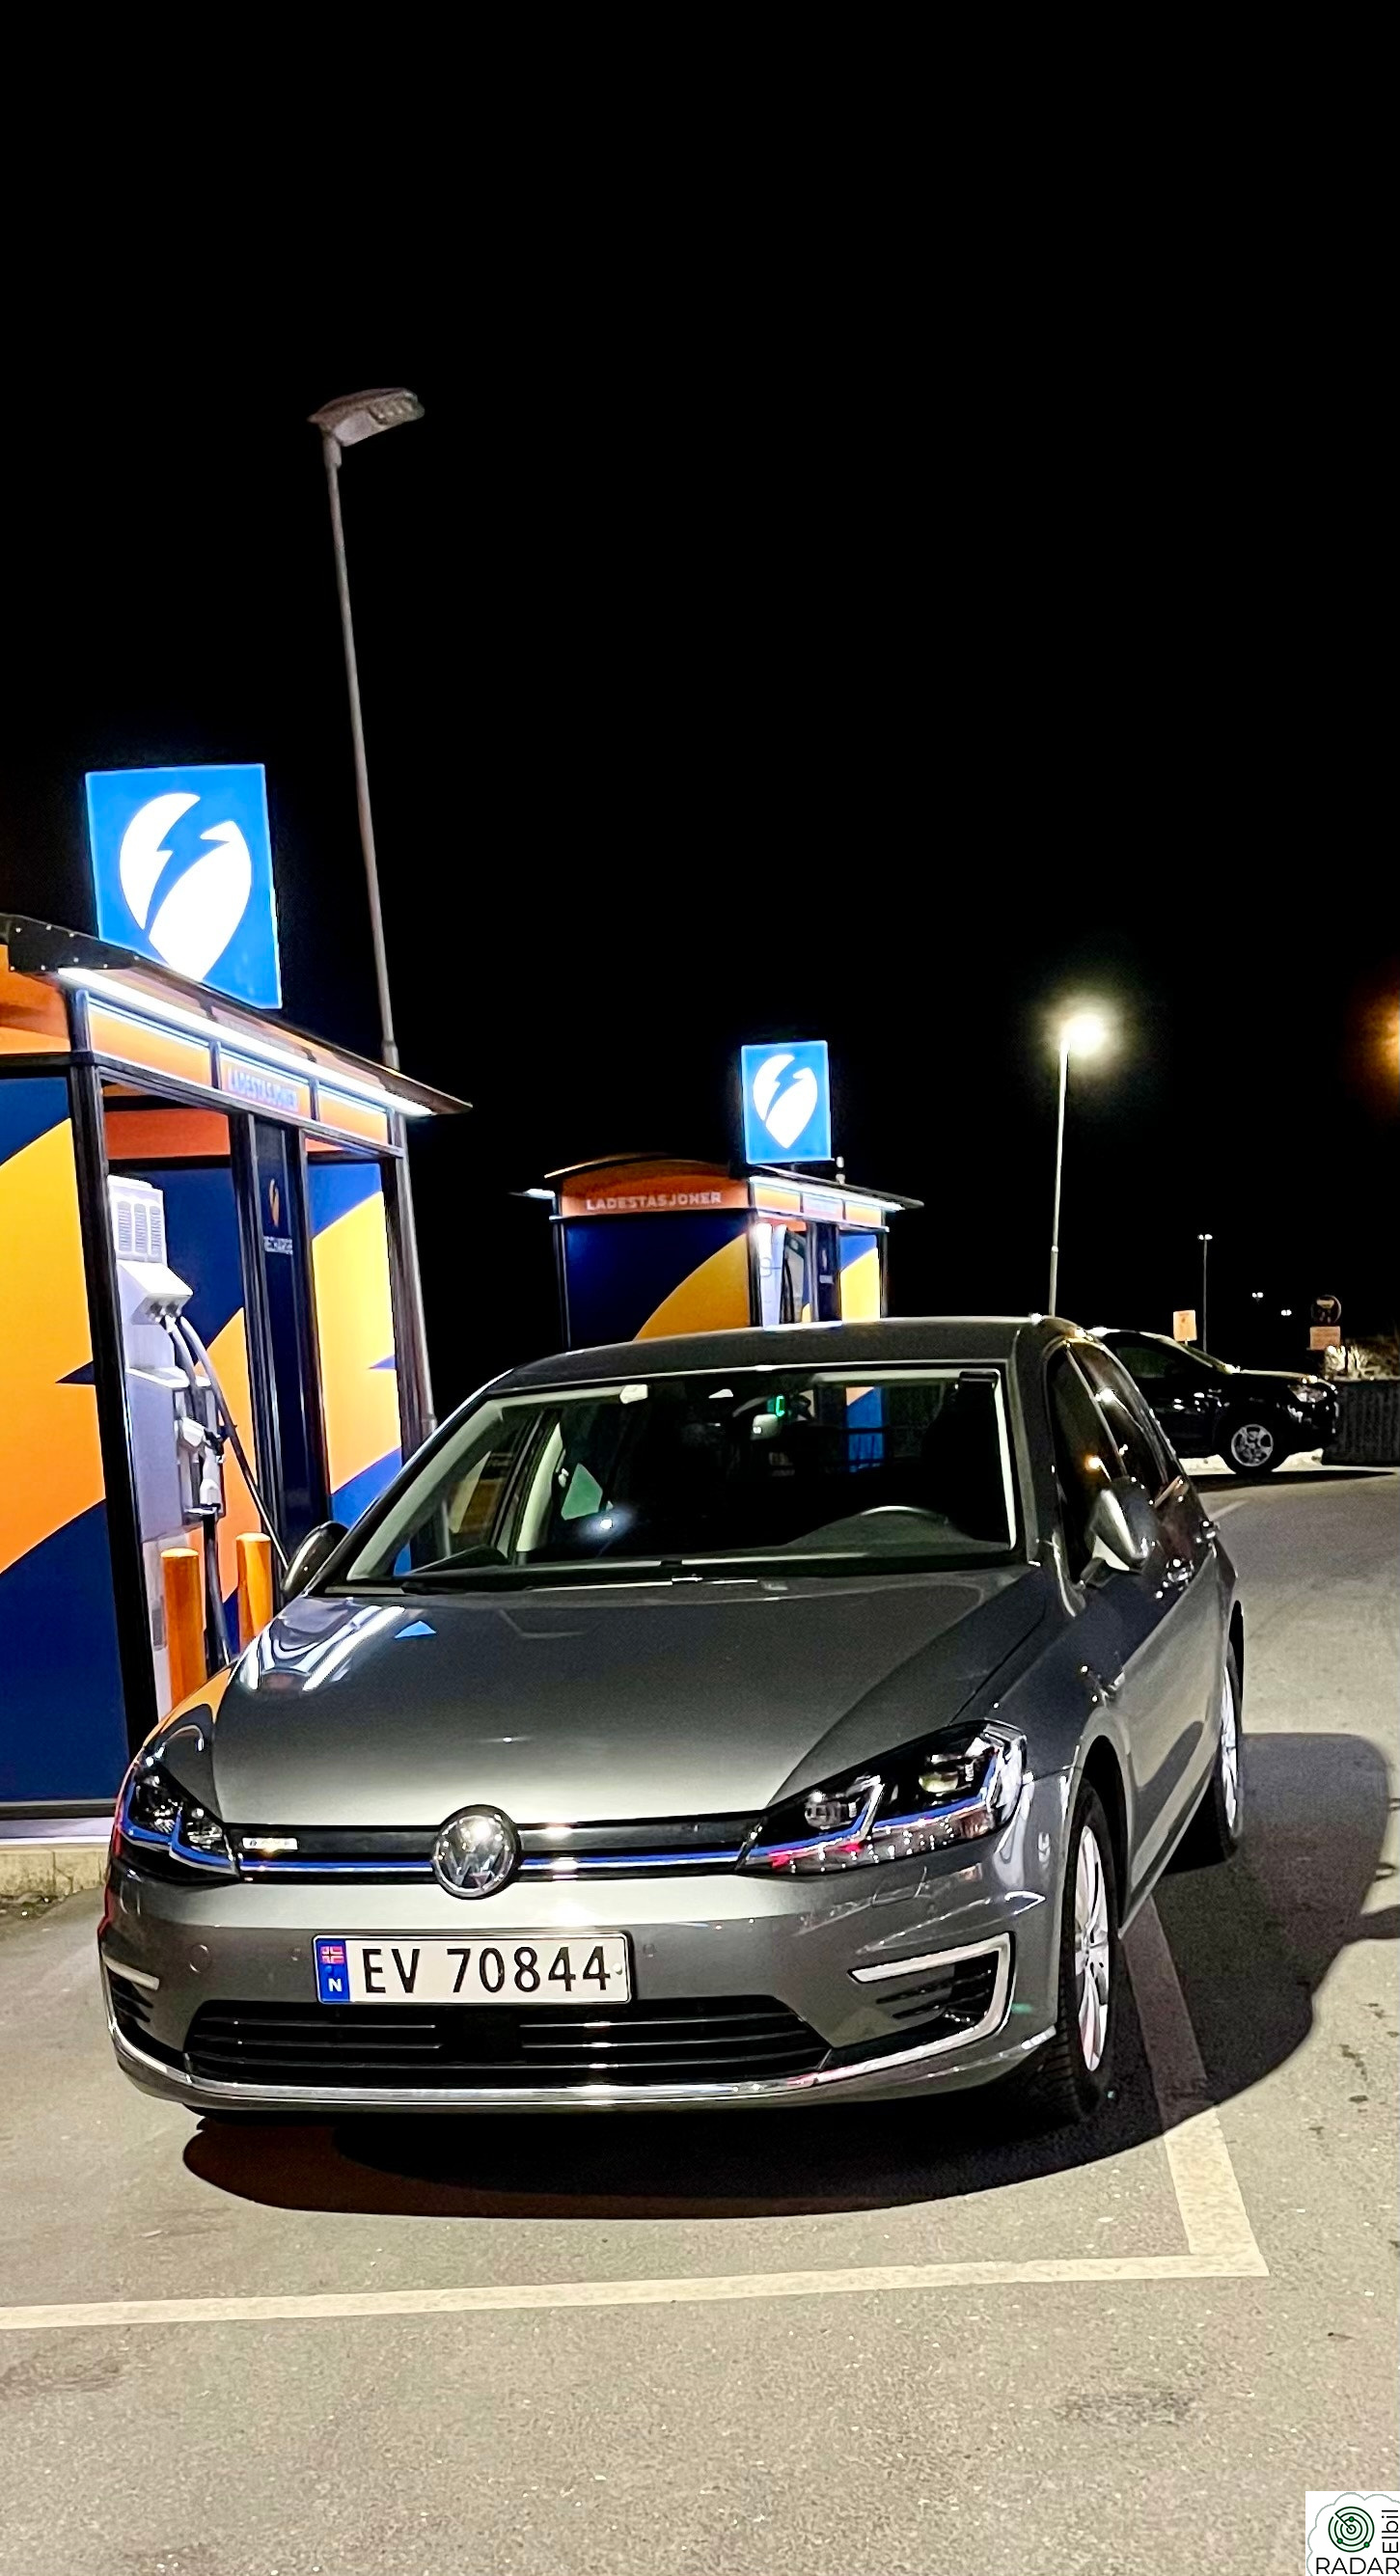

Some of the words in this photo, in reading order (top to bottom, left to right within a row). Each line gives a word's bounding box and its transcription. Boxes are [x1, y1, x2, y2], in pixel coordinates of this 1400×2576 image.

[586, 1192, 722, 1211] LADESTASJONER
[328, 1978, 343, 1993] N
[362, 1948, 421, 1993] EV
[447, 1946, 611, 1992] 70844
